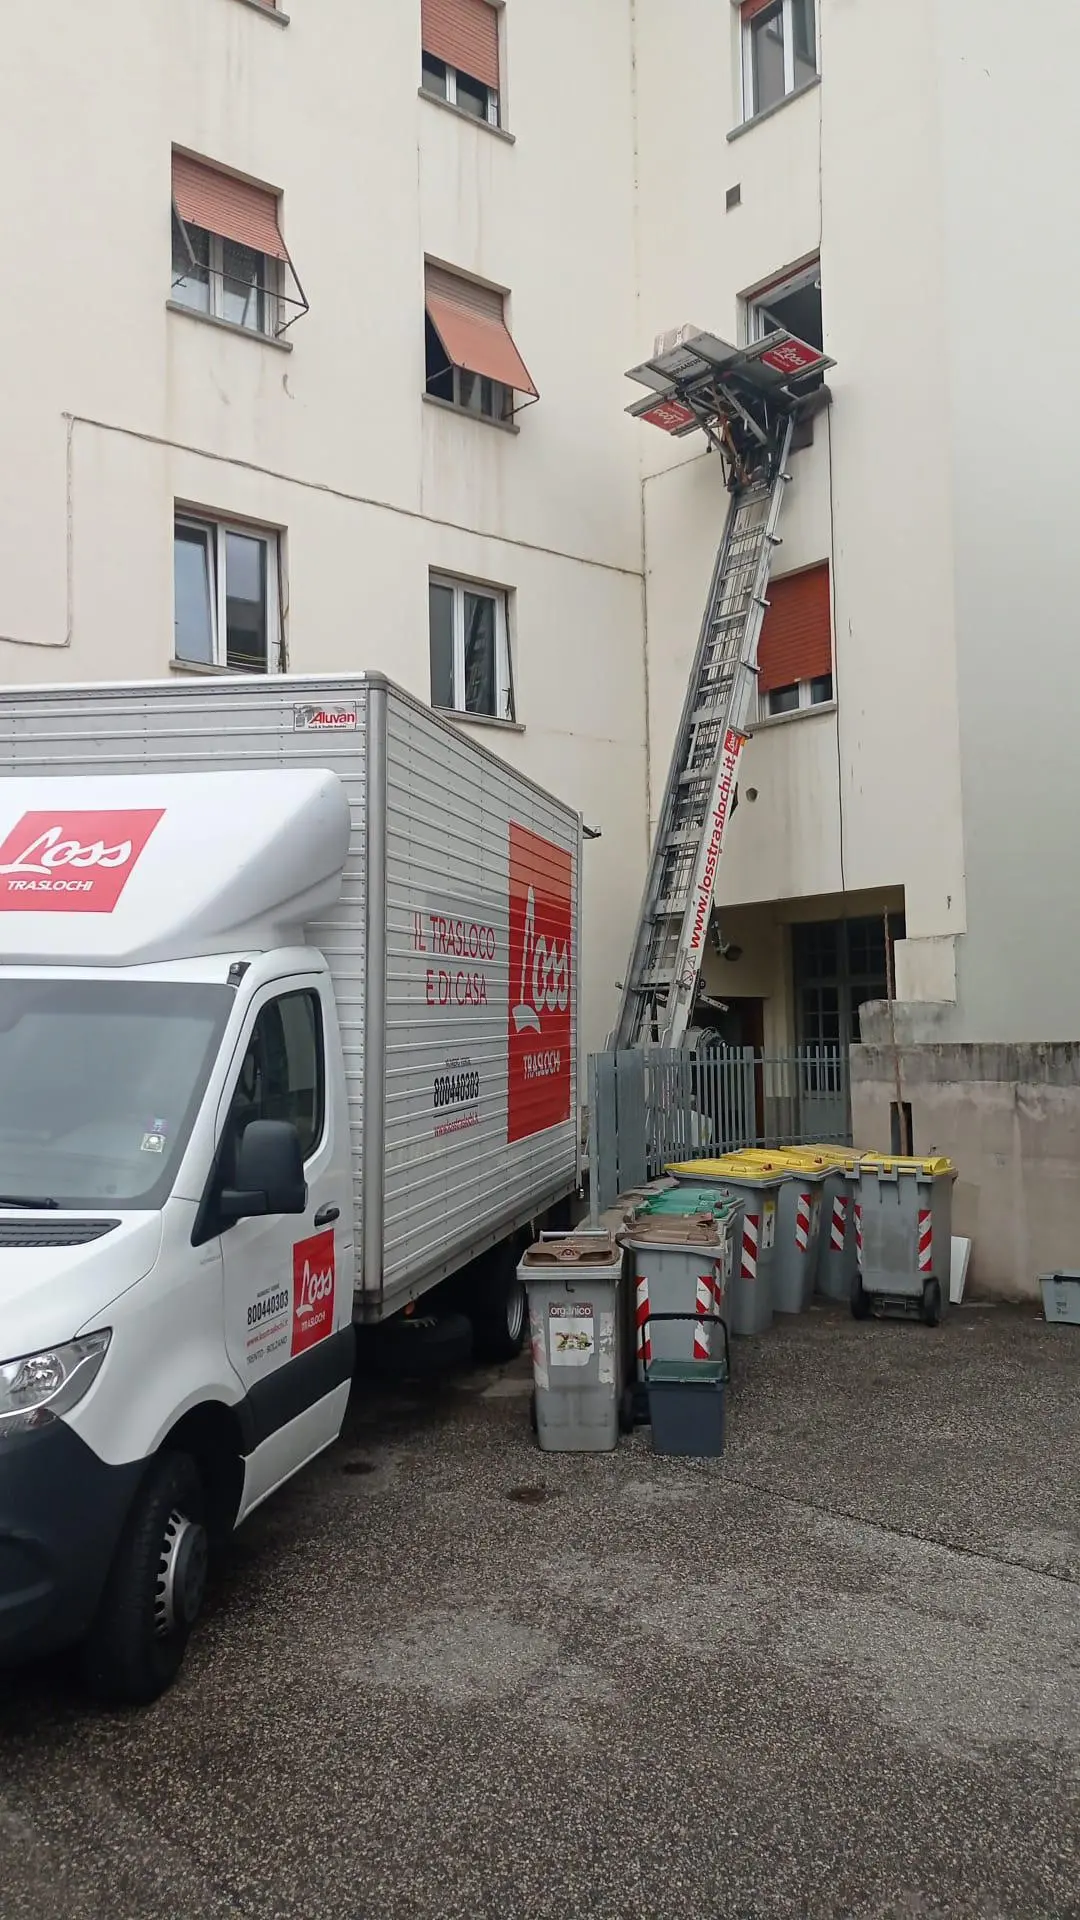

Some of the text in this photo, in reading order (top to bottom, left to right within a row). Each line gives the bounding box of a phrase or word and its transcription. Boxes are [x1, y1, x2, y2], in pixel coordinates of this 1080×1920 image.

[309, 711, 355, 724] Aluvan
[0, 826, 132, 875] Loss
[690, 755, 736, 949] www.losstraslochi.it
[7, 880, 94, 891] TRASLOCHI
[414, 911, 496, 961] IL TRASLOCO
[426, 969, 434, 1005] E
[455, 970, 488, 1006] CASA
[434, 1071, 479, 1108] 800440303
[296, 1259, 333, 1317] Loss
[247, 1289, 289, 1325] 800440303
